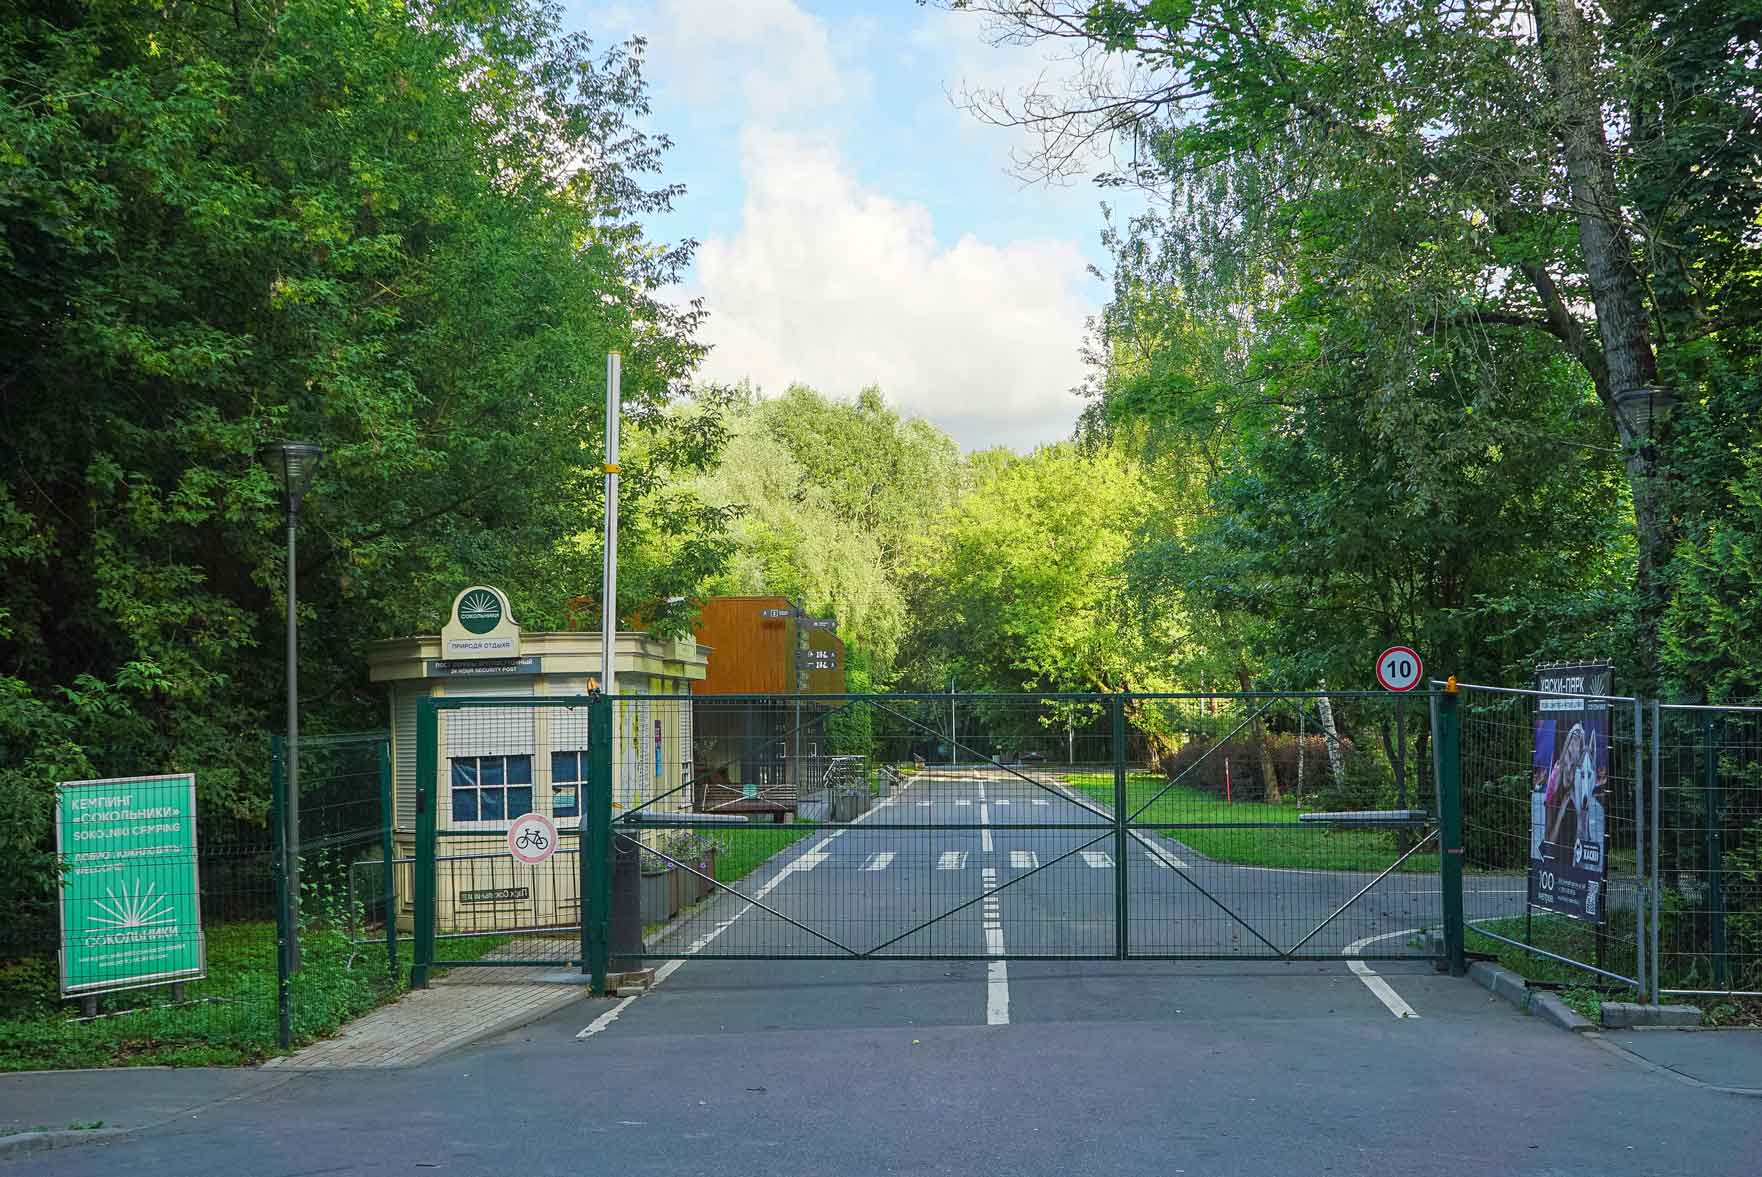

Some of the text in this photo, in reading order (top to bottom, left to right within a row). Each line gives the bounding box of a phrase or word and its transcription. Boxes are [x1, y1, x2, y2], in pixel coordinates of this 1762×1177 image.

[1387, 660, 1411, 678] 10
[1540, 676, 1585, 693] ХАСКИ-ПАРК
[72, 795, 132, 810] КЕМПИНГ
[72, 807, 180, 824] «СОКОЛЬНИКИ»
[1539, 871, 1554, 890] 100
[85, 927, 178, 948] СОКОЛЬНИКИ
